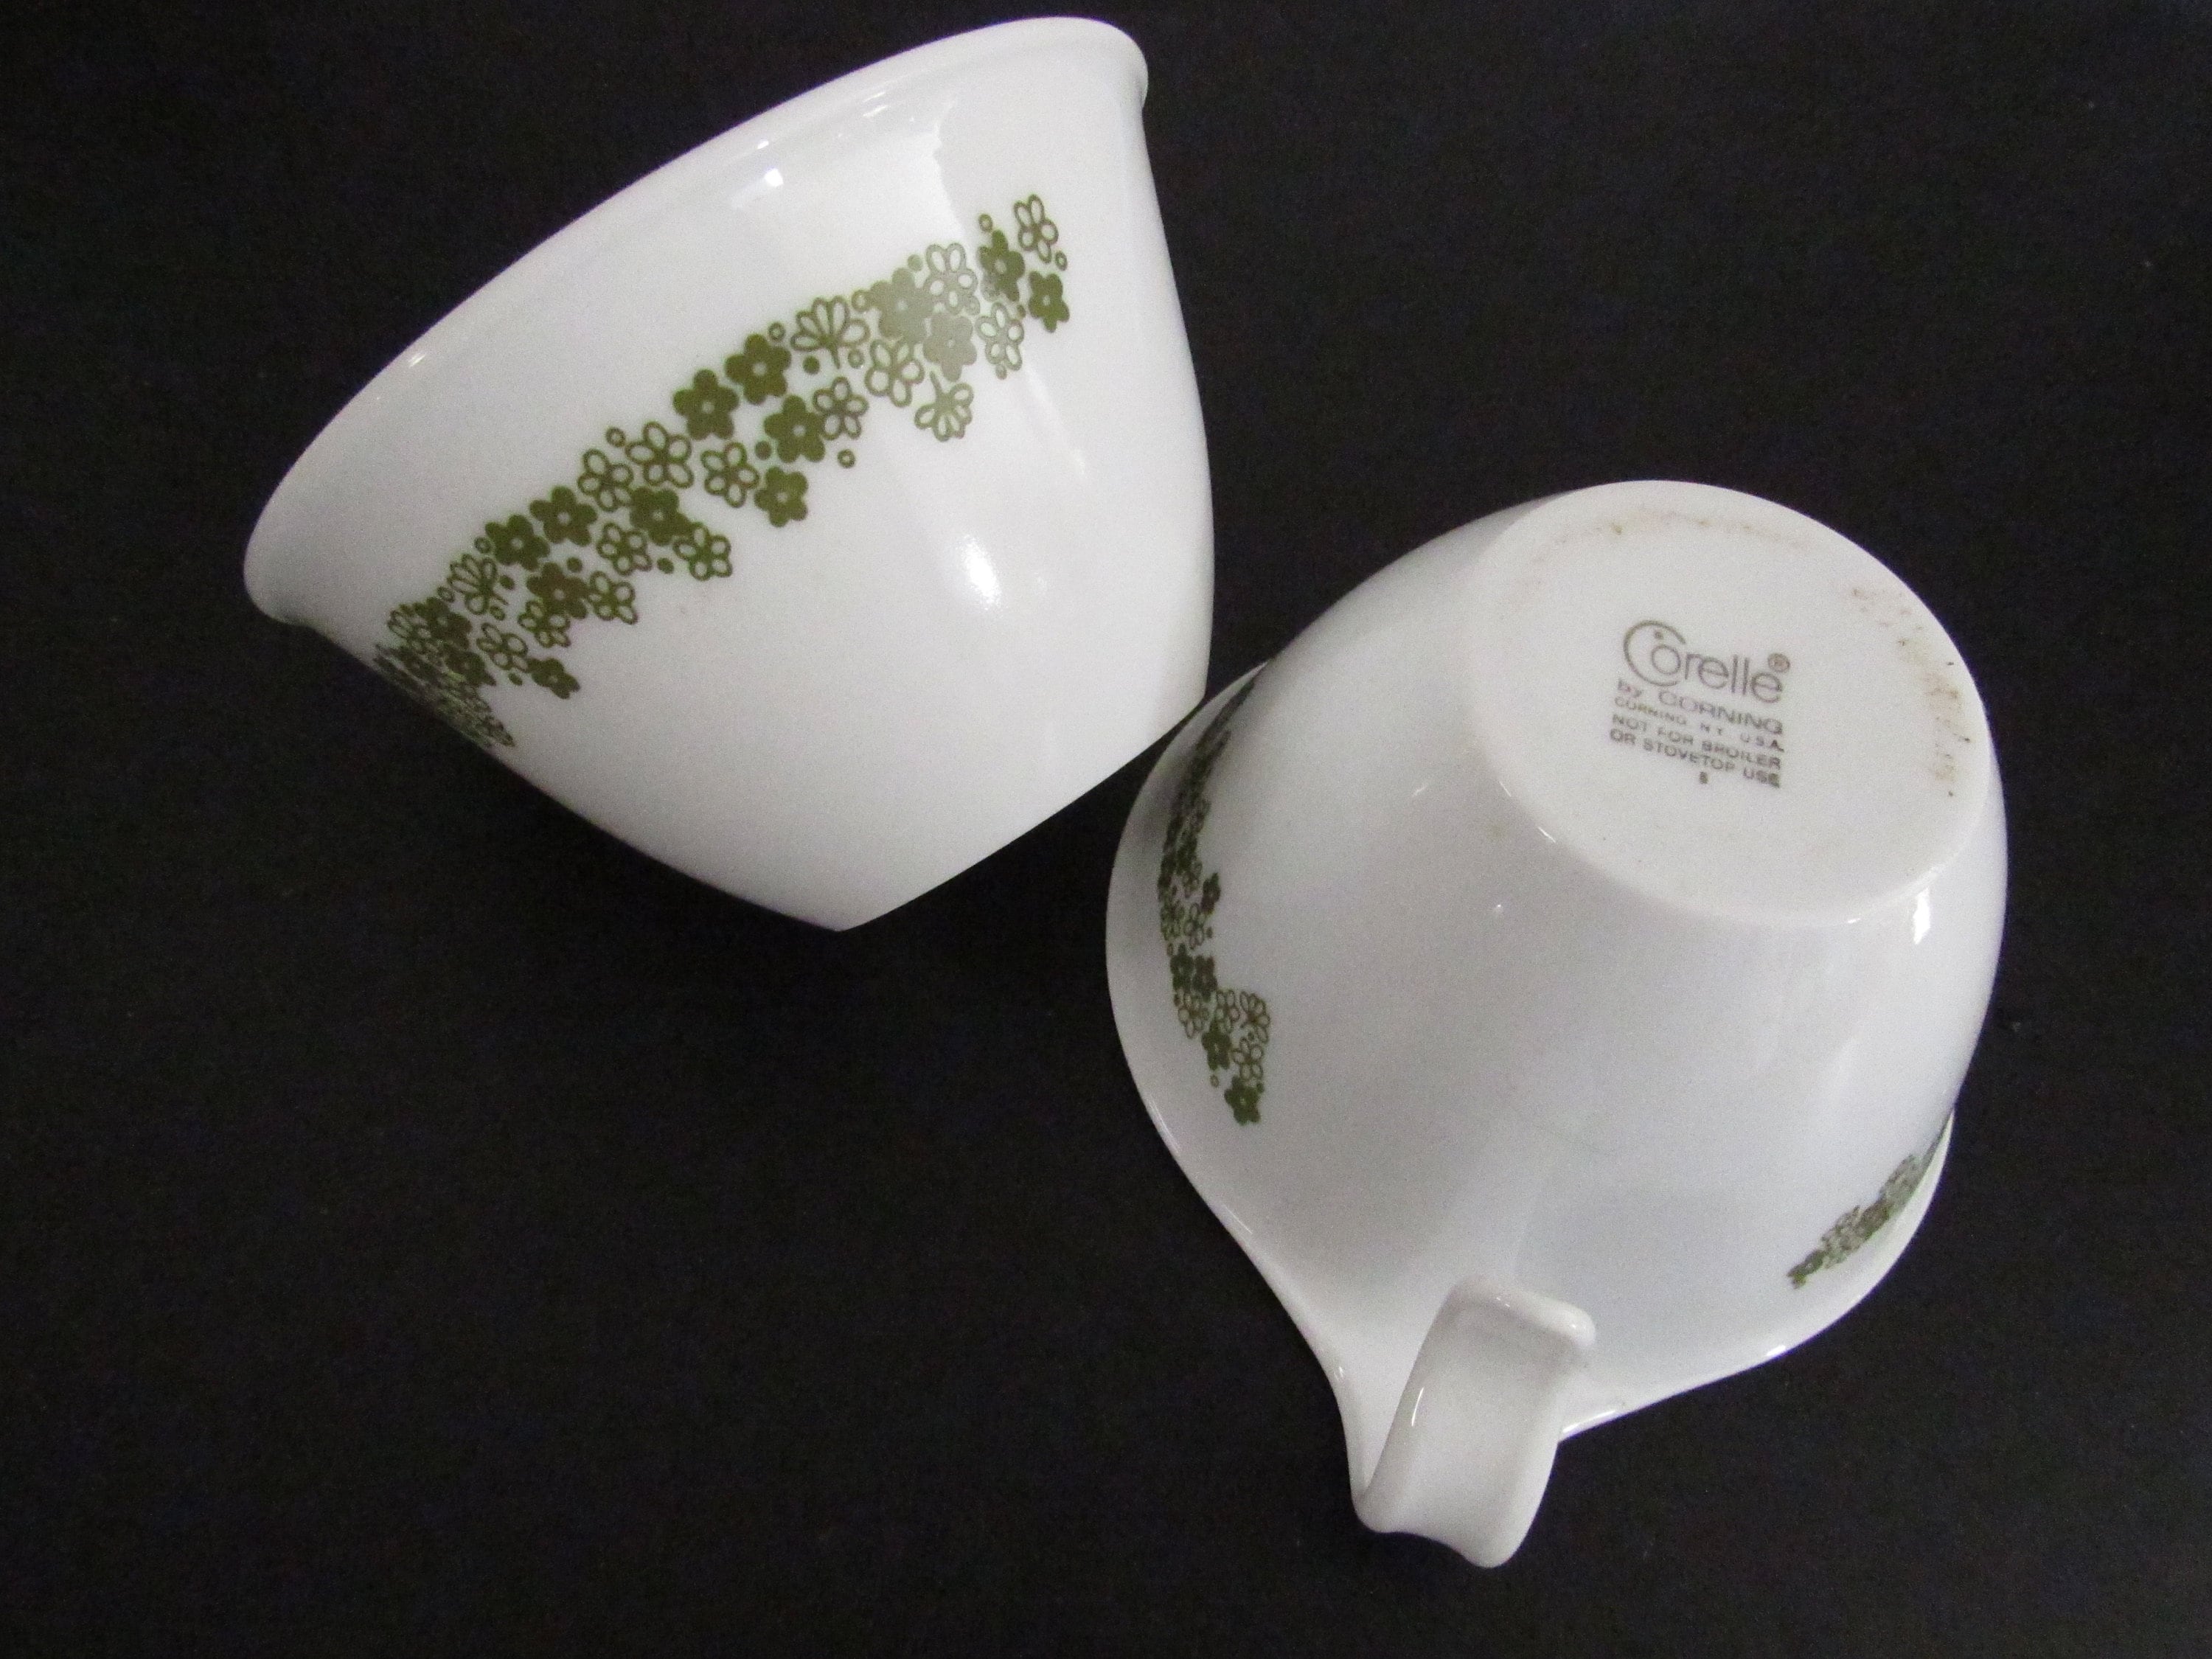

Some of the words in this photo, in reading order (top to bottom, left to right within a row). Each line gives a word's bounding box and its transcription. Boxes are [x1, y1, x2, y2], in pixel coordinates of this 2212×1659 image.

[1658, 691, 1783, 734] CORNING
[1610, 728, 1636, 745] OR
[1643, 737, 1735, 771] STOVETOP
[1743, 767, 1780, 788] USE
[1613, 714, 1647, 731] NOT
[1658, 727, 1694, 745] FOR
[1702, 740, 1781, 770] BROILER
